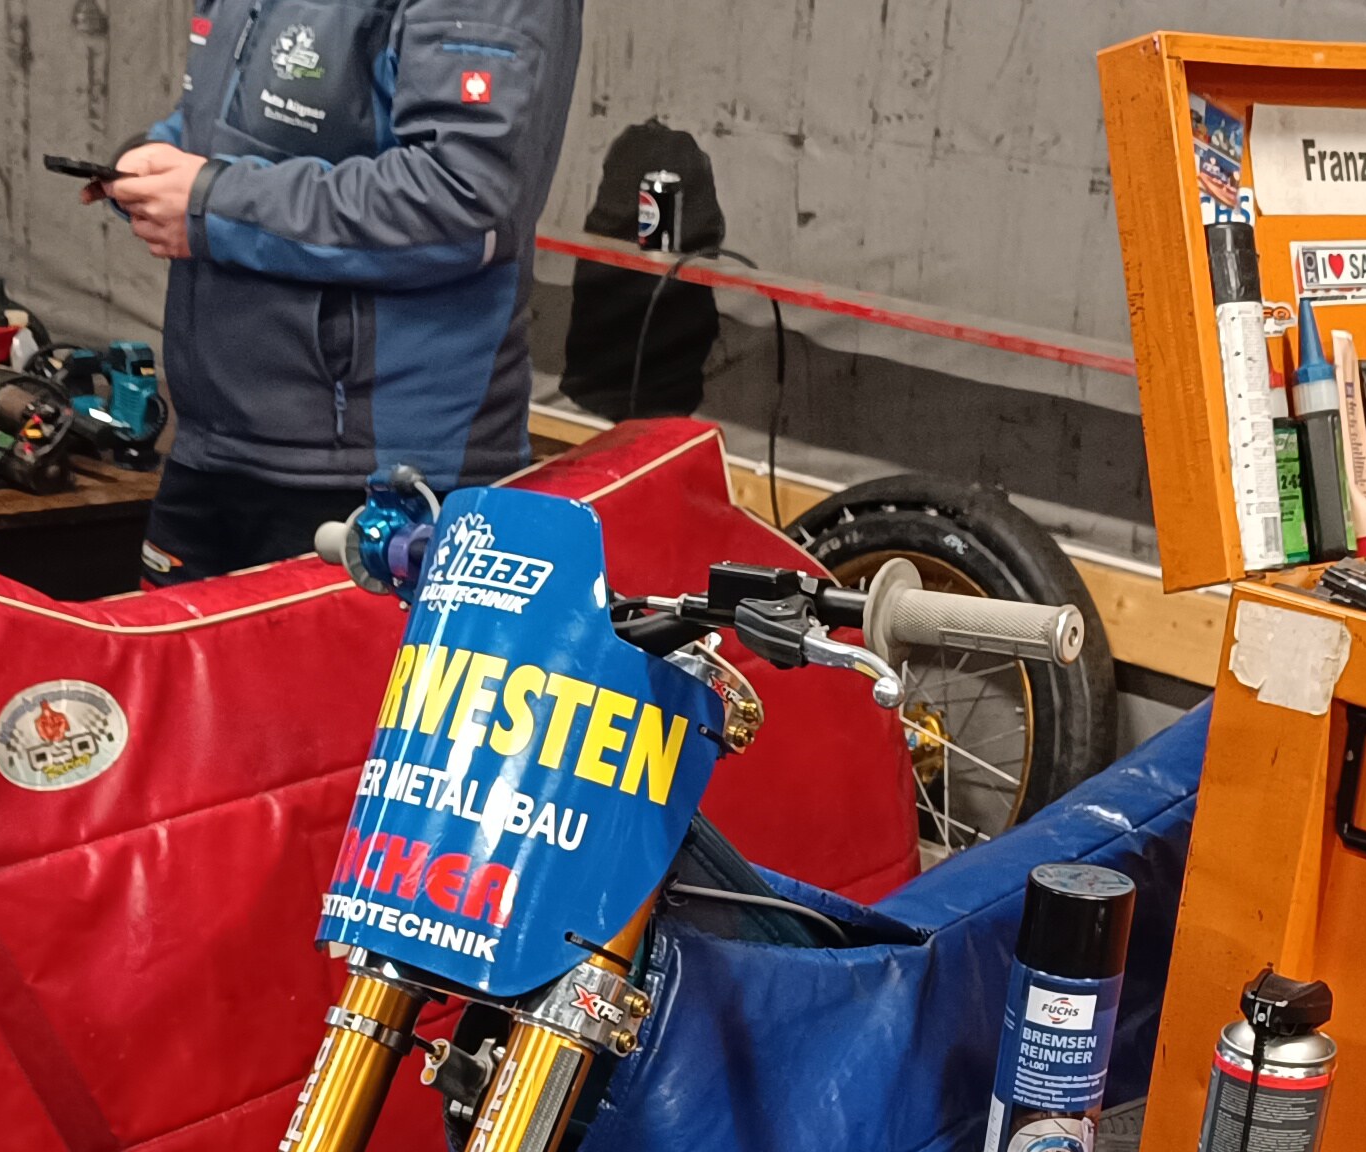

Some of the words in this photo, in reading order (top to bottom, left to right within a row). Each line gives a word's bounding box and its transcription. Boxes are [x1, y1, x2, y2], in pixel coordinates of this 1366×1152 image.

[384, 760, 589, 851] METALBAU
[1041, 1002, 1081, 1018] FUCHS
[1022, 1026, 1098, 1050] BREMSEN
[1019, 1041, 1094, 1065] REINIGER
